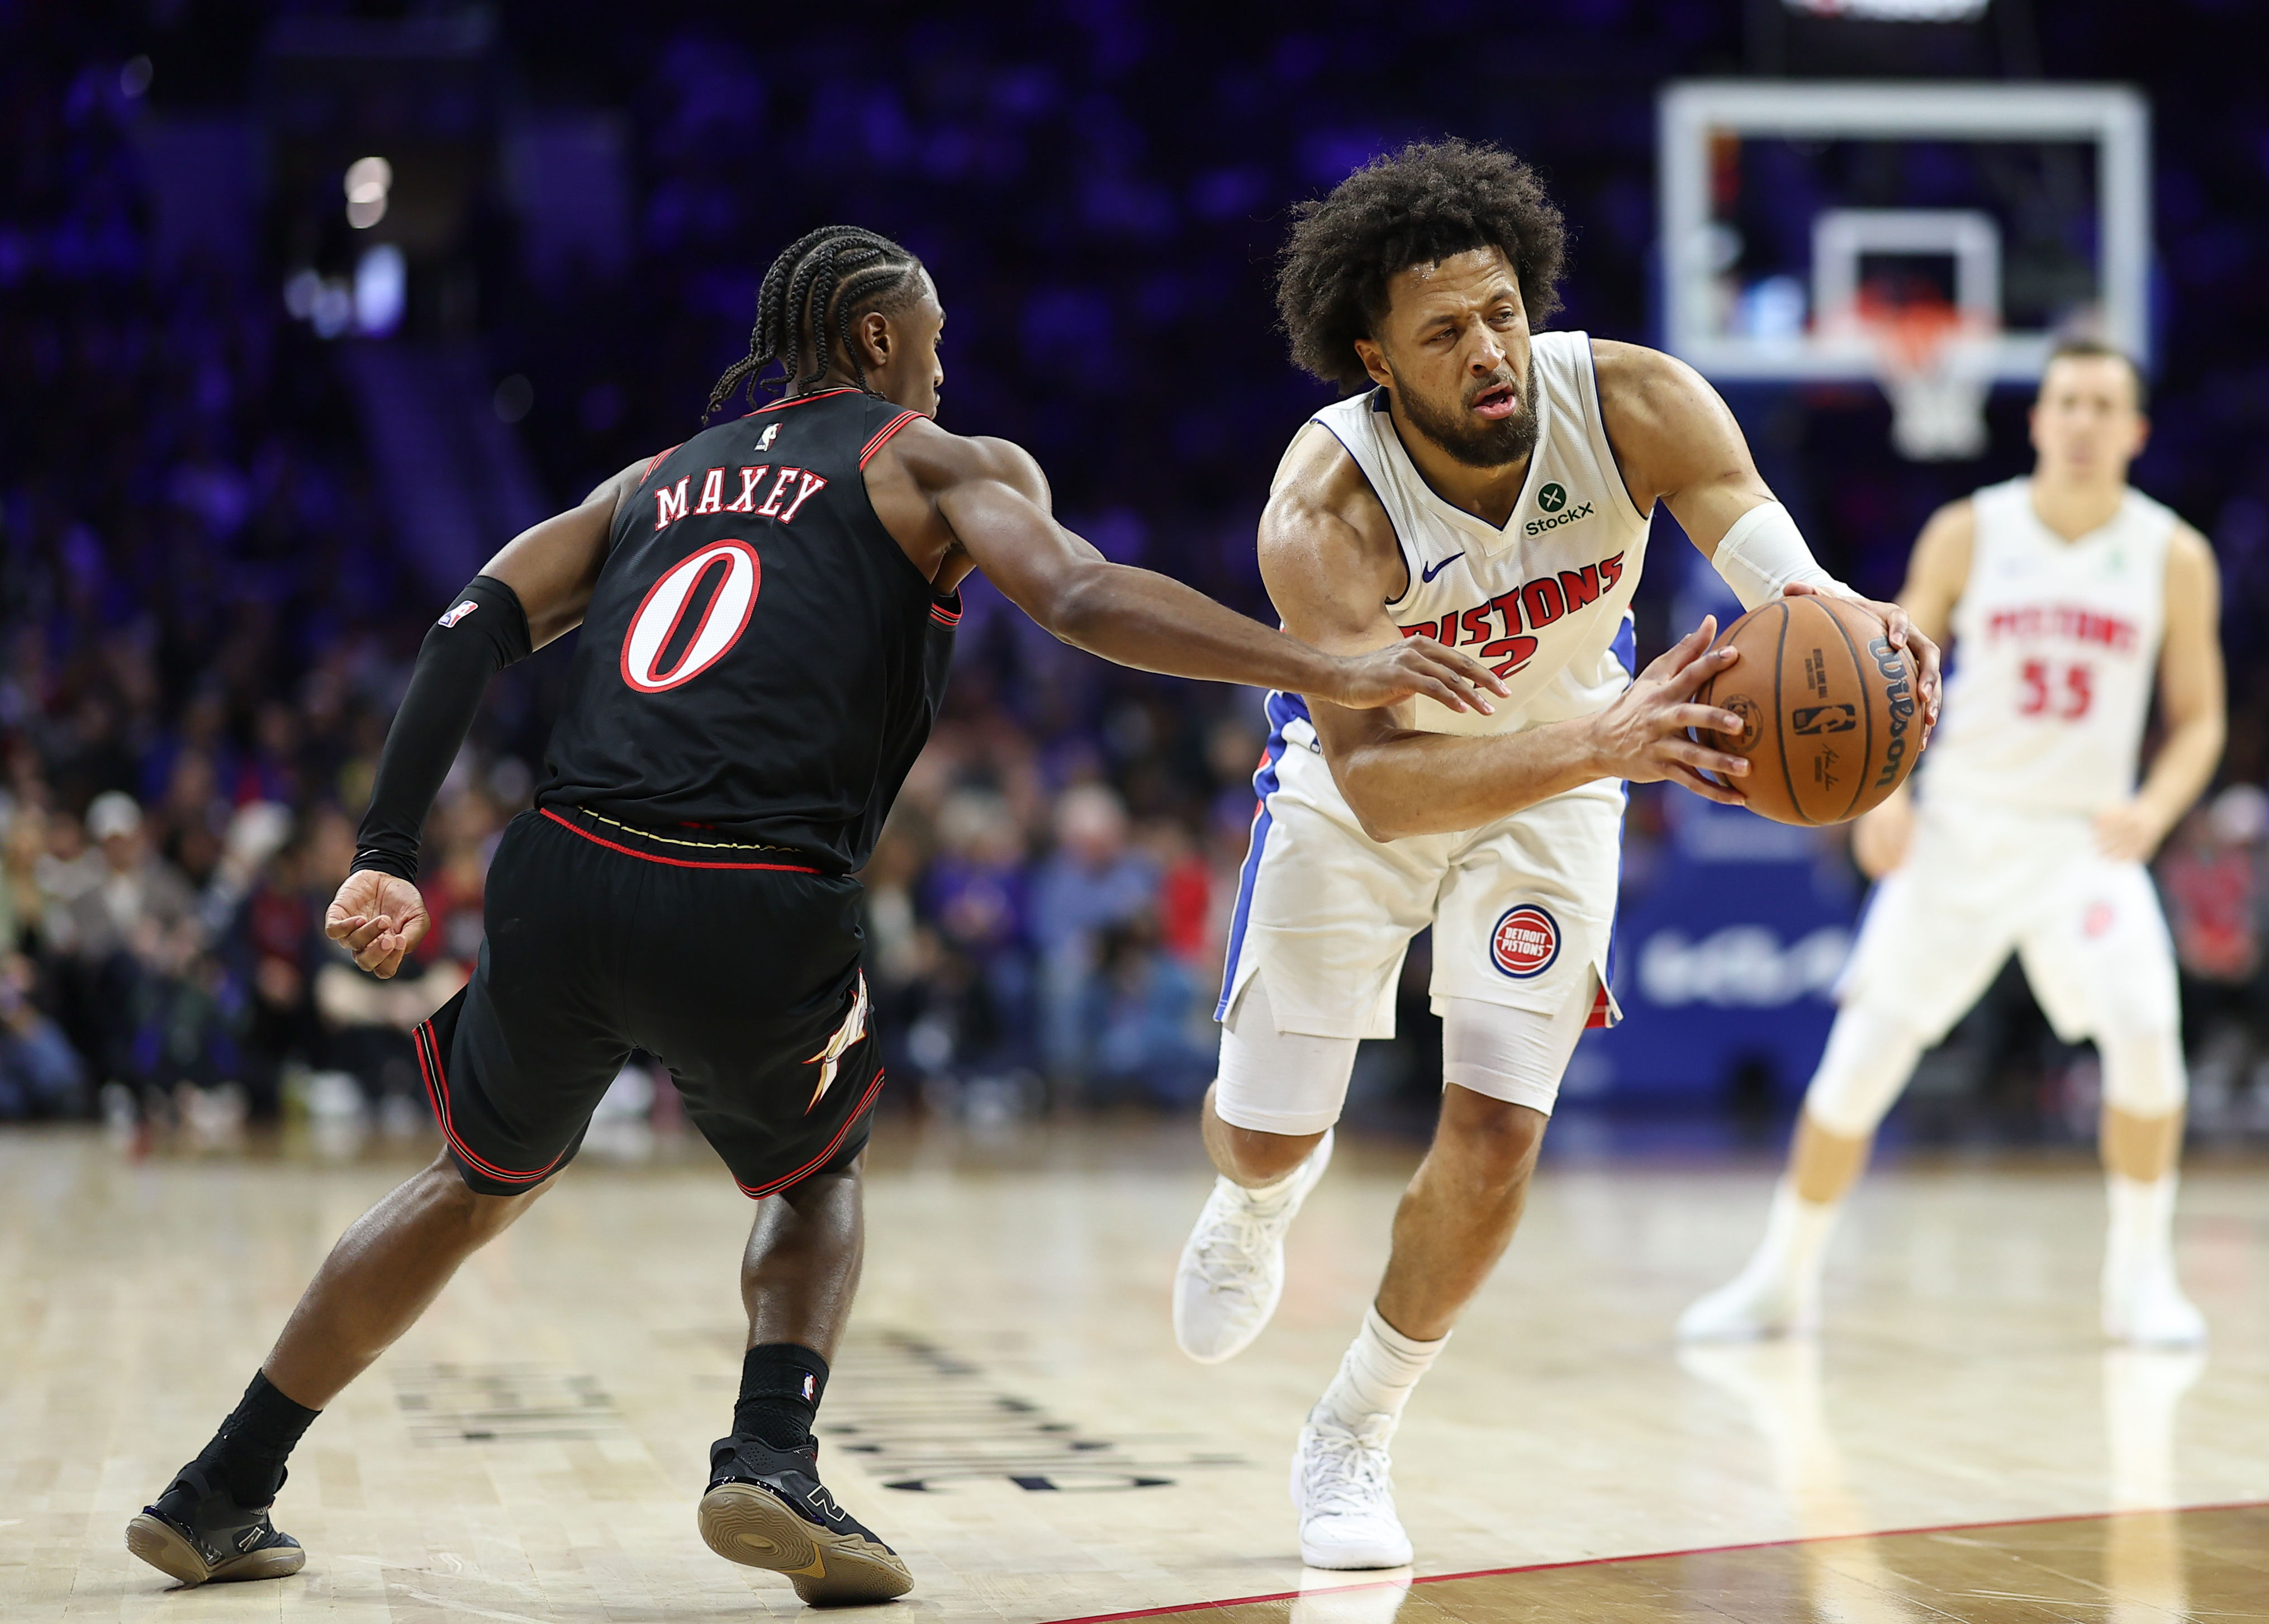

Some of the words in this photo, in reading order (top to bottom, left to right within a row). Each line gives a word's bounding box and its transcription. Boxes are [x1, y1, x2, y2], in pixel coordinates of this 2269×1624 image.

[654, 465, 828, 531] MAXEY
[1526, 501, 1594, 535] StockX
[620, 539, 761, 694] 0
[1474, 635, 1539, 688] 2
[2018, 658, 2094, 722] 55
[1501, 939, 1545, 957] PISTONS
[1504, 927, 1548, 944] DETROIT
